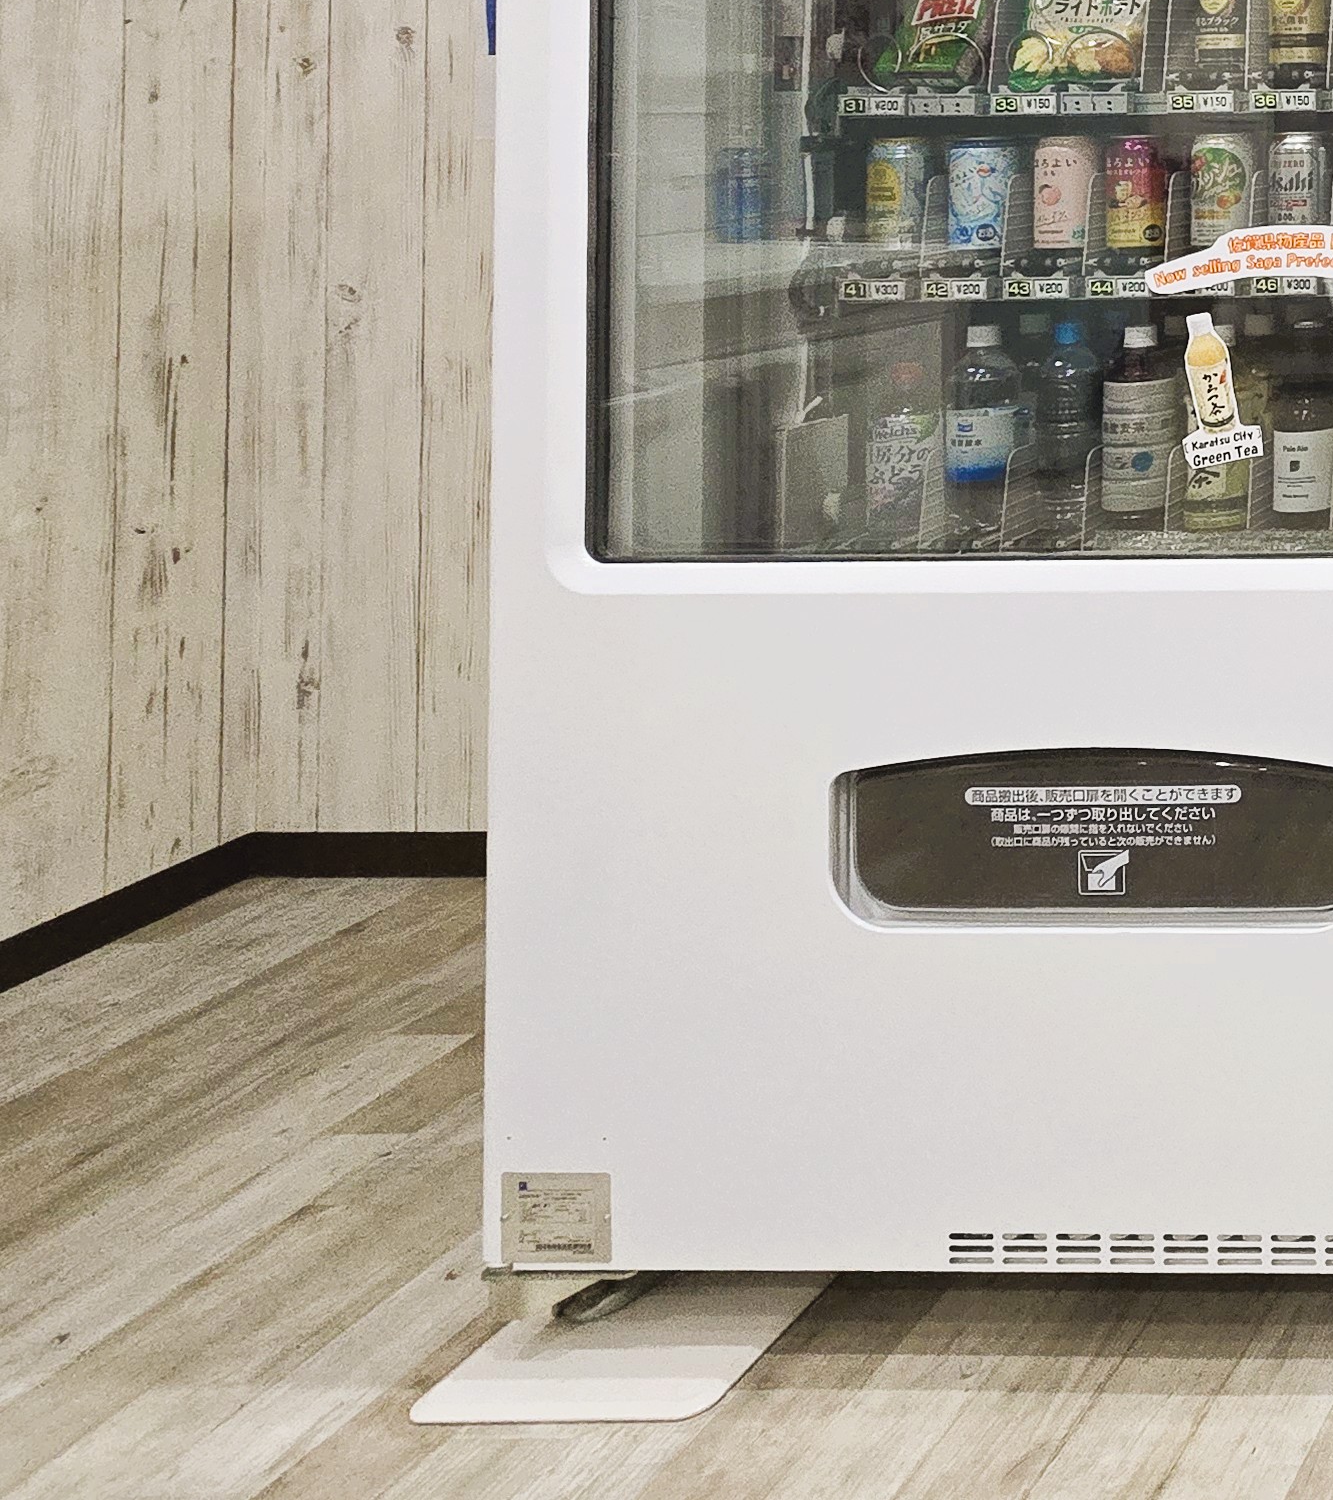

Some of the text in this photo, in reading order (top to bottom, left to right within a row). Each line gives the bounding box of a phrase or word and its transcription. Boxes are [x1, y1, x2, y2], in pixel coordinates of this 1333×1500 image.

[1026, 98, 1050, 111] ¥150
[1285, 94, 1310, 107] ¥150
[1155, 267, 1187, 288] Now
[1193, 257, 1240, 280] selling
[1246, 254, 1282, 272] Saga
[956, 283, 981, 295] ¥200
[1286, 278, 1311, 290] ¥300
[1192, 431, 1255, 451] Karatsu City
[1193, 445, 1259, 467] Green Tea
[990, 807, 1216, 822] 商品は、一つずつ取り出してください
